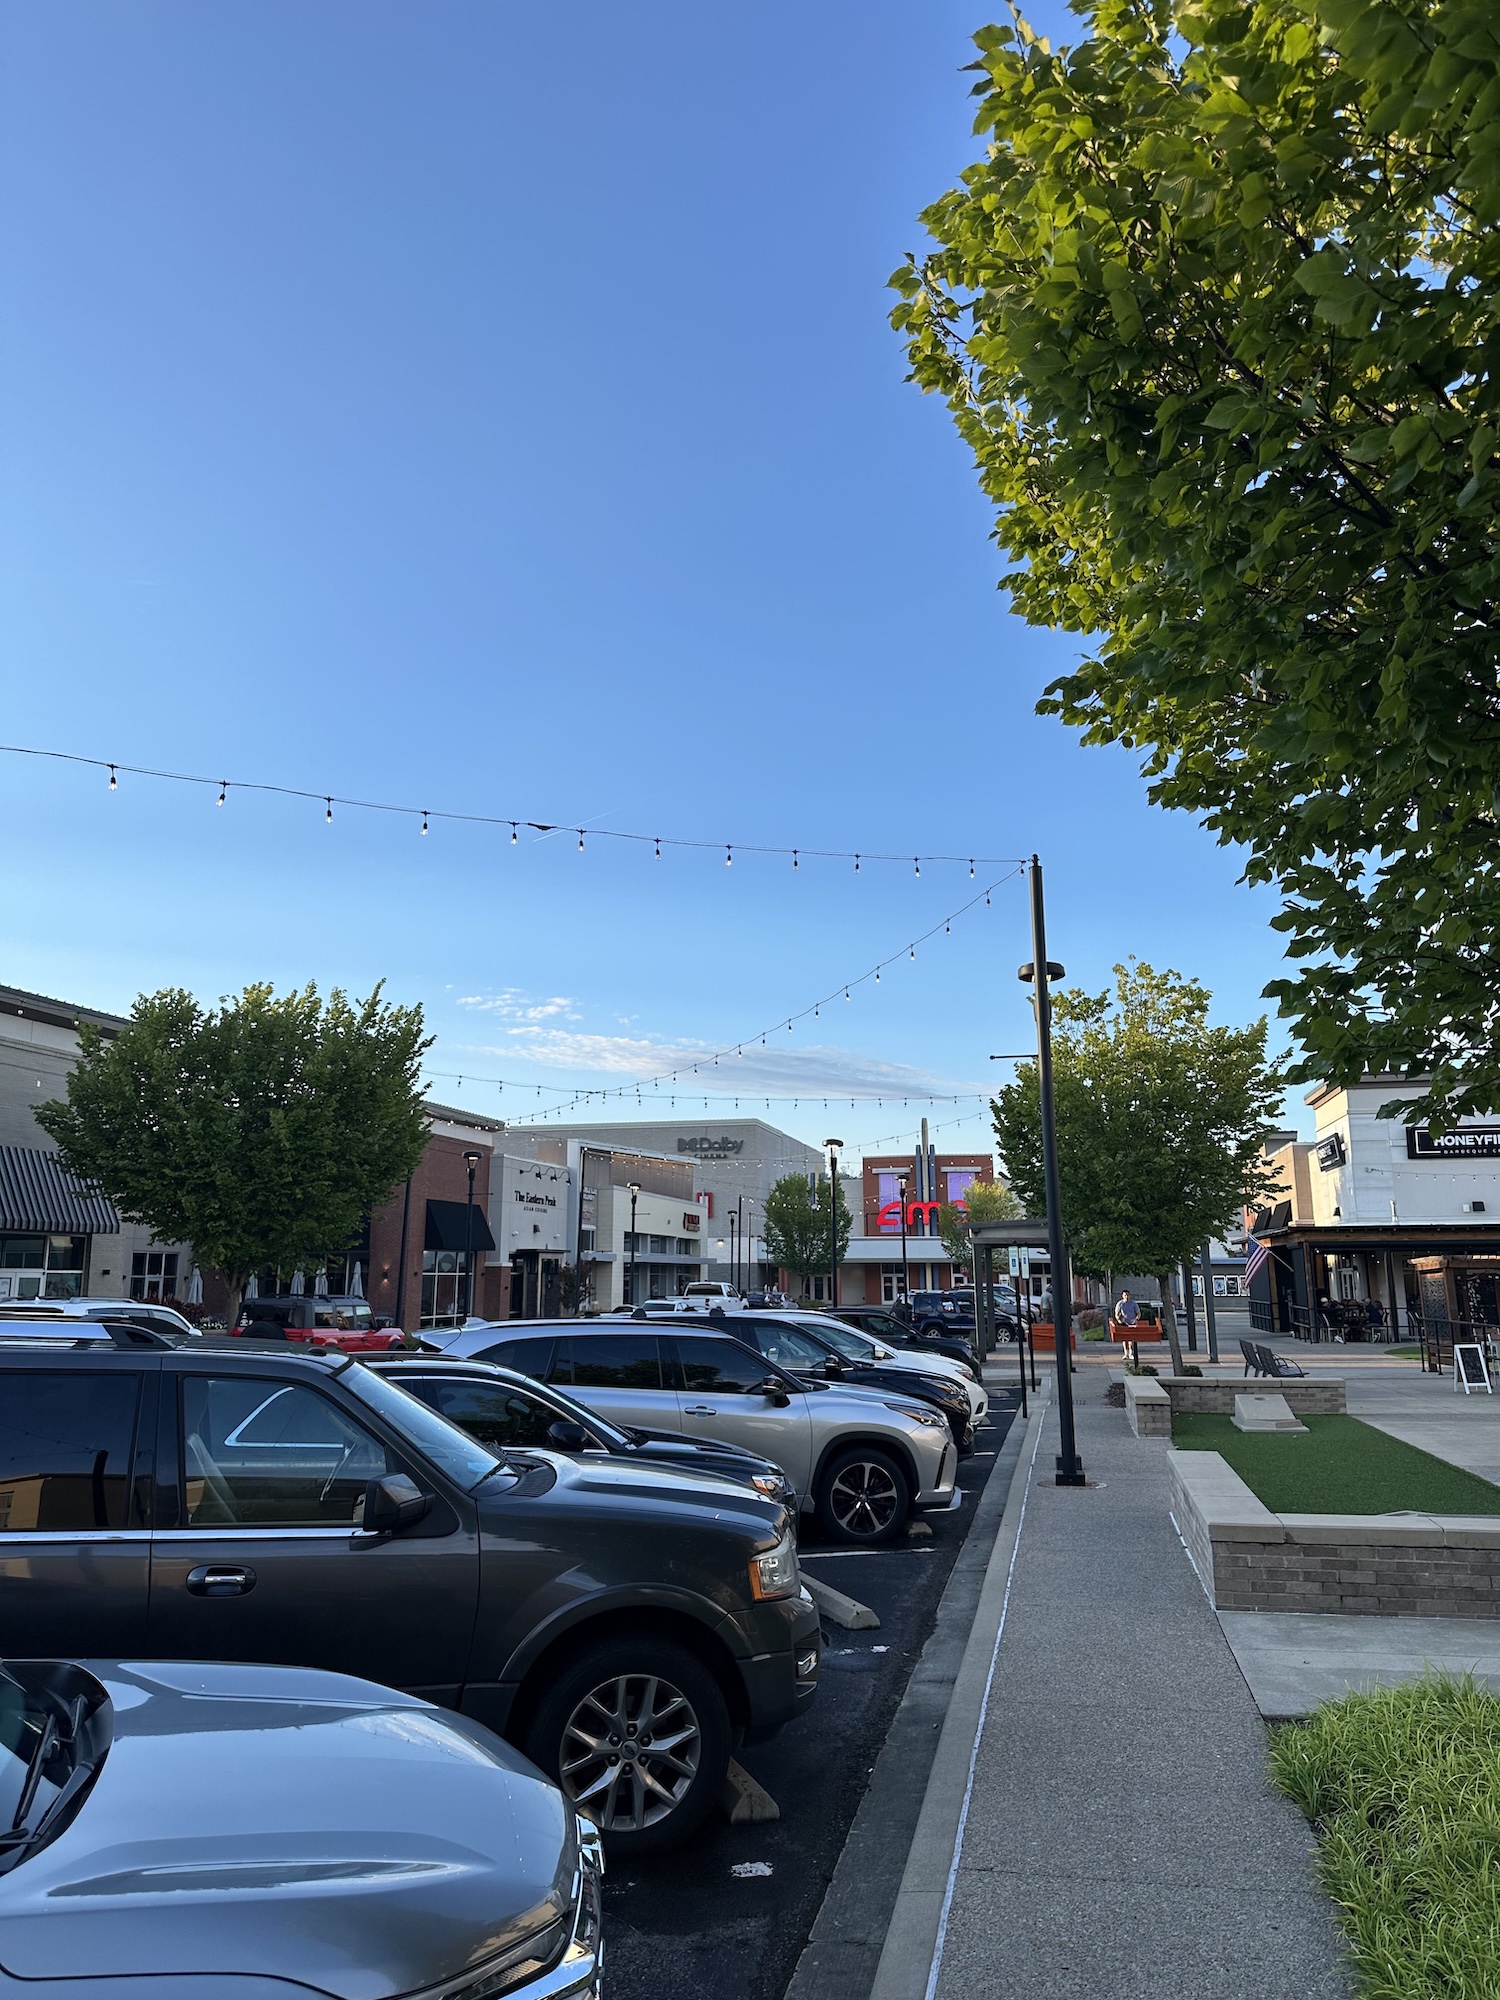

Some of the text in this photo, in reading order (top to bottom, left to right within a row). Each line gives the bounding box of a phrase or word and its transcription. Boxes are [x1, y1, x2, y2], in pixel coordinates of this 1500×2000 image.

[699, 1136, 744, 1154] Dolby
[1434, 1134, 1500, 1146] HONEYFI
[514, 1190, 557, 1206] The Eastern Peak
